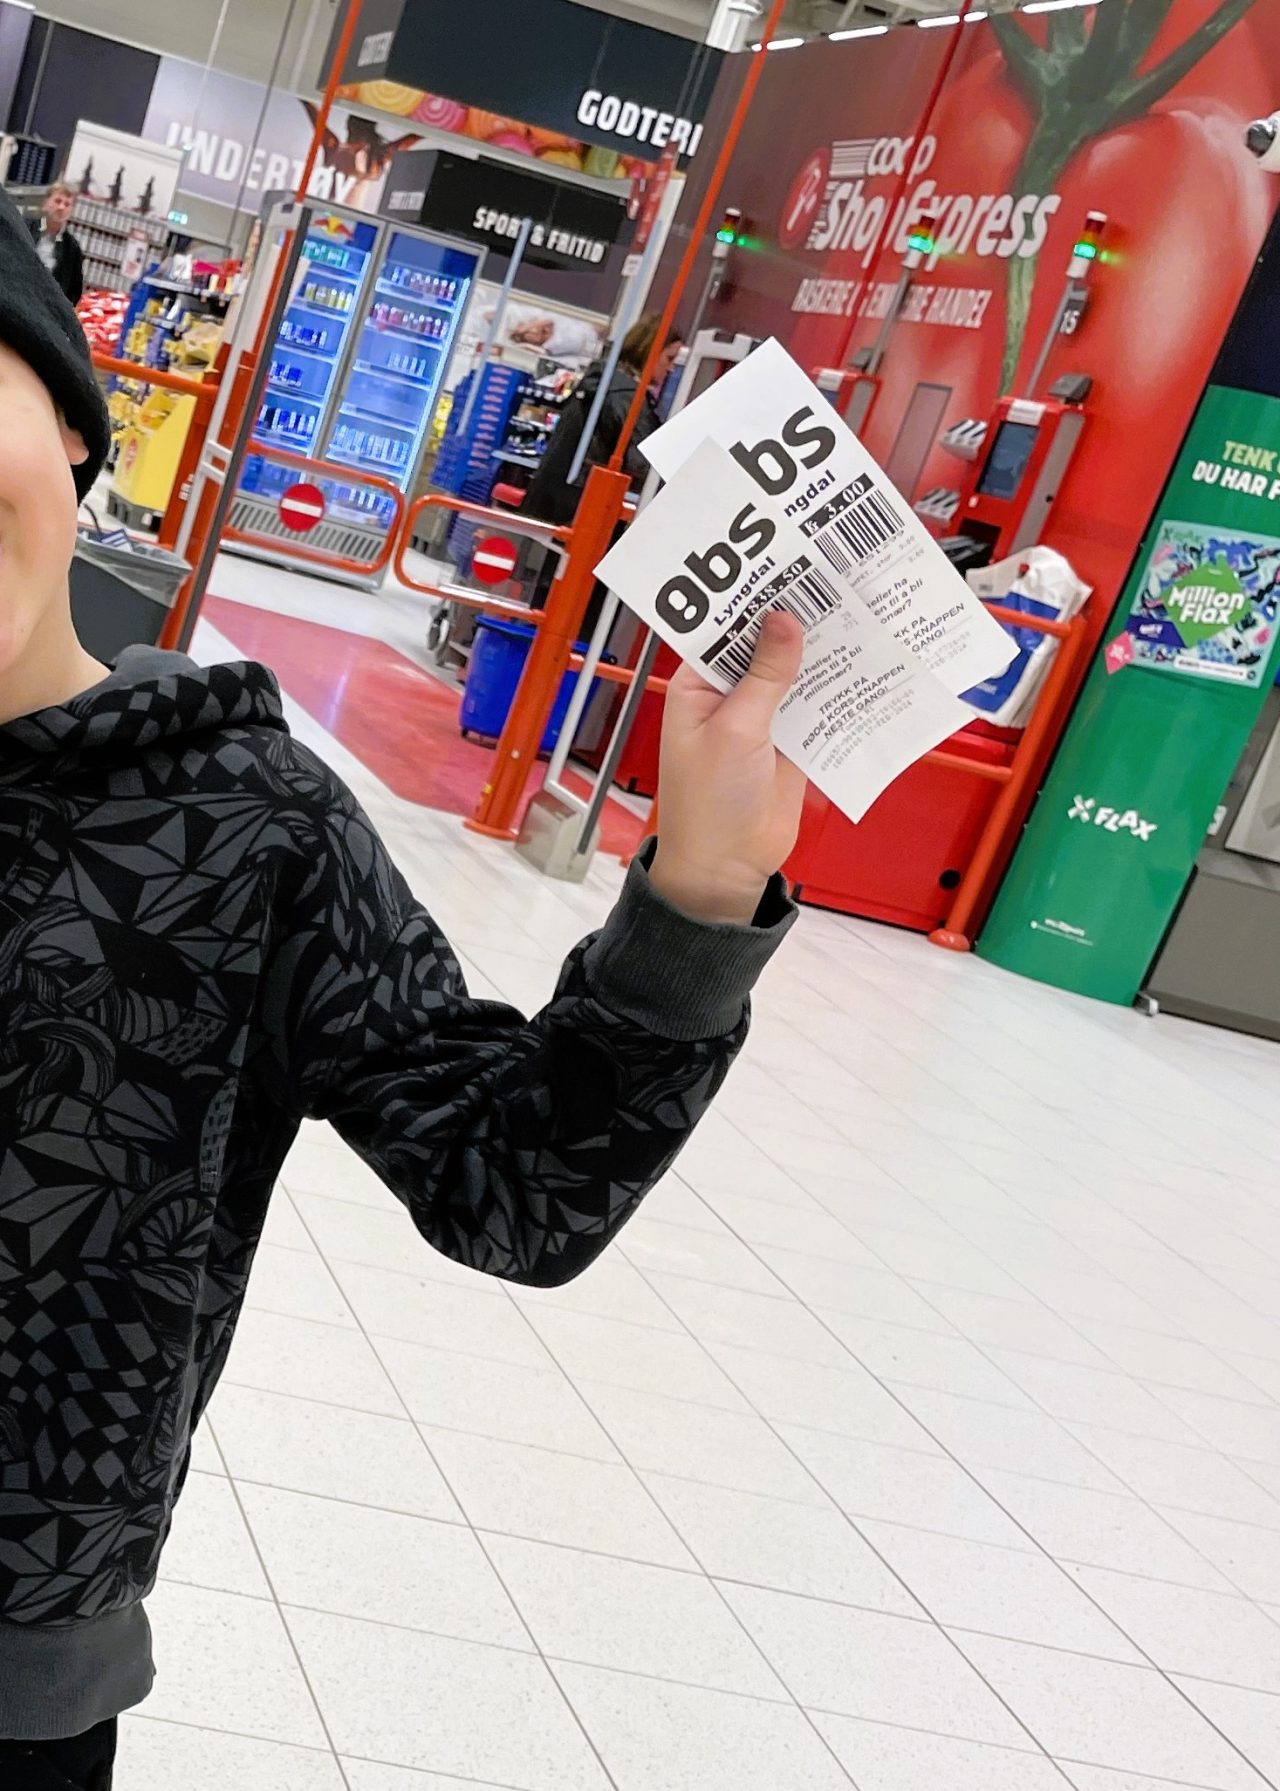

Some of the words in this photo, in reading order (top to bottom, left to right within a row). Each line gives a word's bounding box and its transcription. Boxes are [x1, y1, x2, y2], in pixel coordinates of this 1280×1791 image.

[577, 89, 703, 157] GODTERI
[473, 206, 528, 240] SPOR
[530, 224, 545, 246] &
[546, 229, 606, 264] FRITID
[728, 405, 836, 496] bs
[1222, 440, 1278, 473] TENK
[783, 470, 835, 518] ngdal
[1192, 460, 1221, 485] DU
[1220, 467, 1267, 497] HAR
[823, 481, 864, 517] 3.00
[655, 502, 776, 634] Obs
[713, 556, 776, 627] Lyngdal
[1168, 585, 1245, 610] Million
[1179, 603, 1232, 625] Flax
[819, 686, 854, 715] TRYKK
[827, 664, 906, 724] KORS-KNAPPEN
[823, 708, 857, 740] NESTE
[1094, 807, 1157, 842] FLAX
